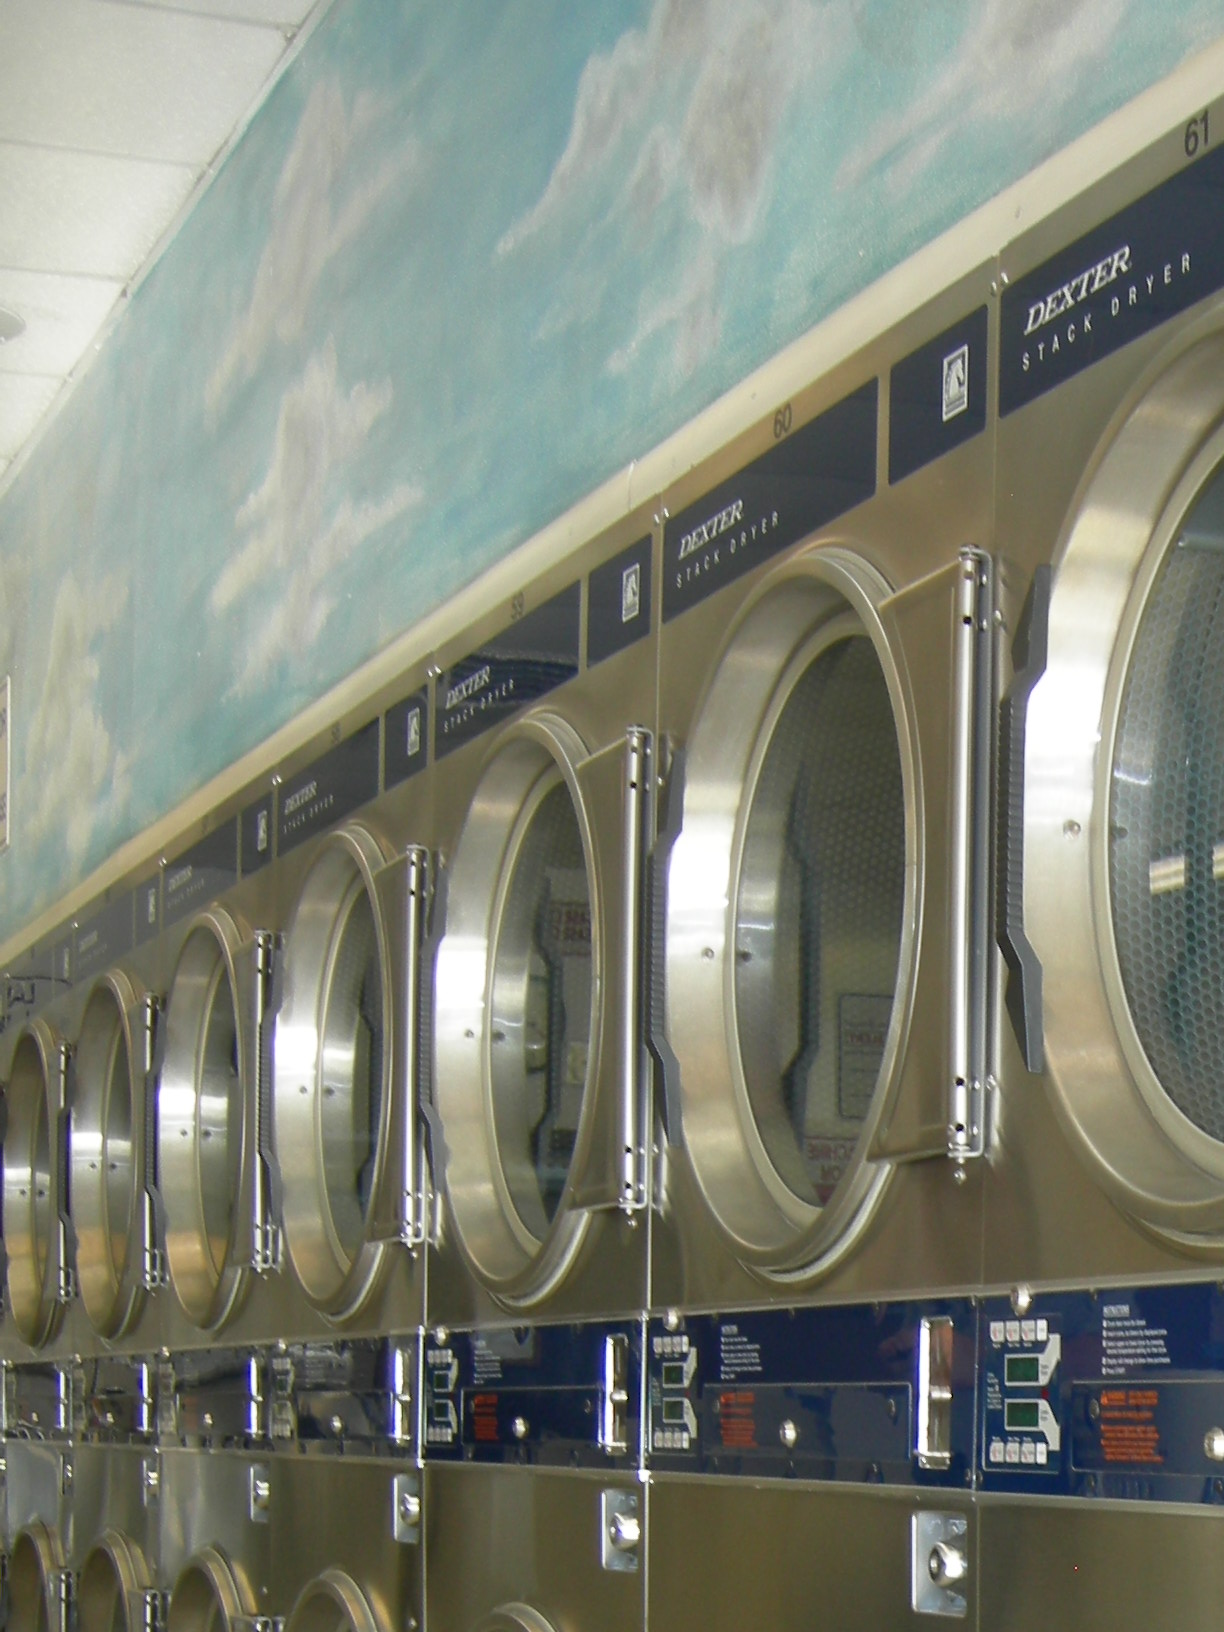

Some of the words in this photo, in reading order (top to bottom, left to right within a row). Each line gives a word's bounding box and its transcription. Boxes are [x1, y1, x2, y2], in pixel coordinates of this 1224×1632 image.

[1184, 109, 1209, 157] 61
[1022, 312, 1092, 371] STACK
[1111, 252, 1191, 317] DRYER
[1023, 245, 1131, 335] DEXTER
[773, 402, 793, 440] 60
[676, 549, 720, 588] STACK
[729, 510, 779, 554] DRYER
[678, 498, 744, 561] DEXTER
[445, 665, 490, 710] DEXTER
